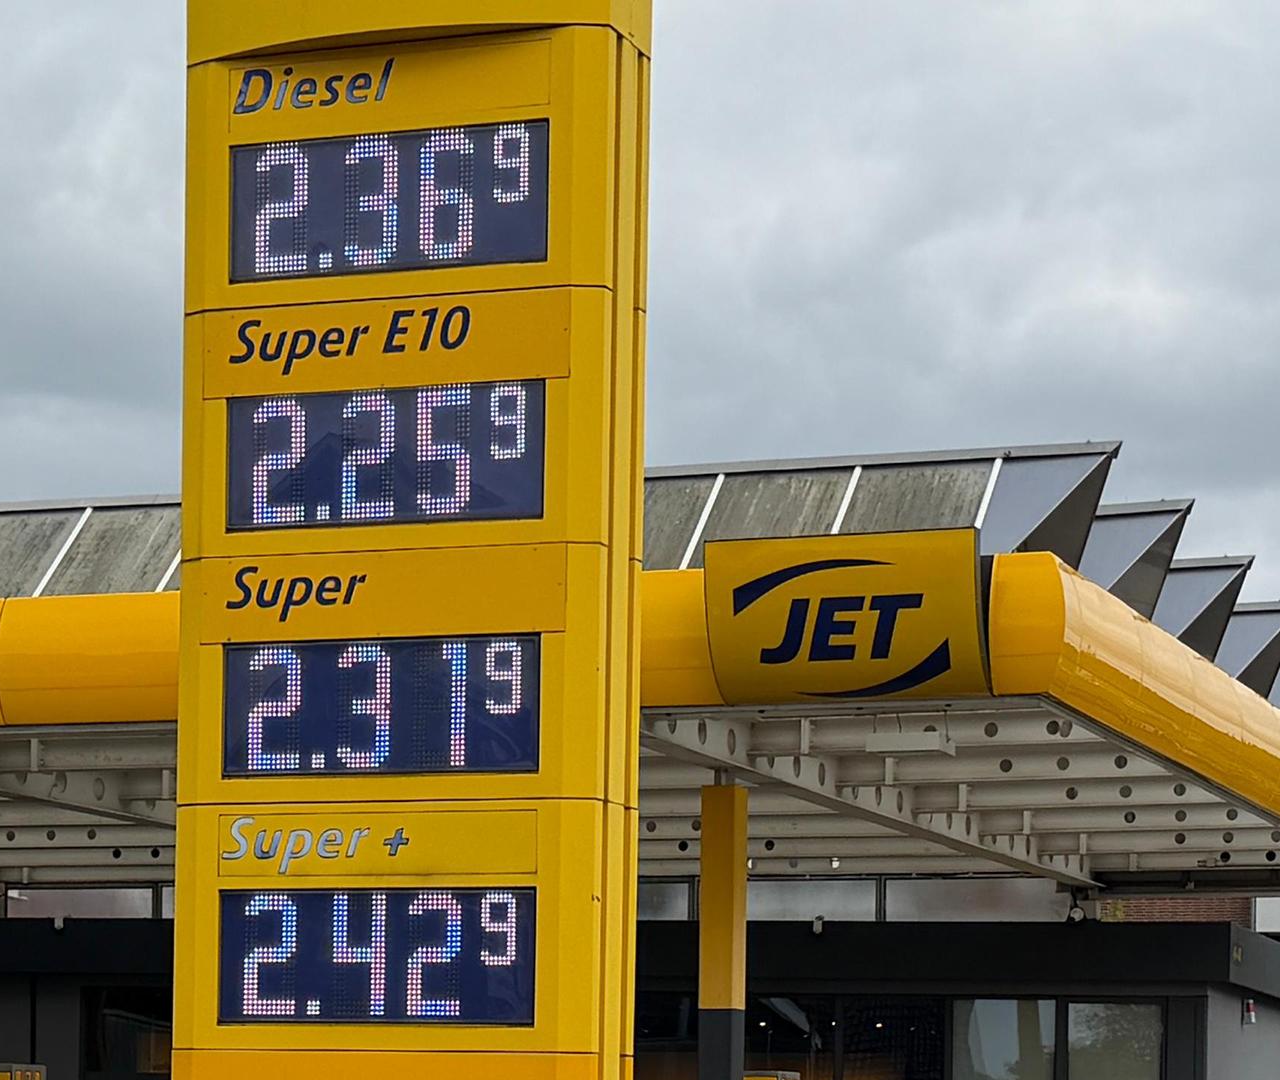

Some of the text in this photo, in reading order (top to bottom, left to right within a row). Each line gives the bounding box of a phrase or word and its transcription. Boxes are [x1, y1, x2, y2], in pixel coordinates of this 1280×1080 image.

[233, 57, 396, 115] Diesel
[228, 305, 472, 376] Super E10
[225, 566, 368, 622] Super
[760, 593, 924, 664] JET
[221, 816, 411, 875] Super +
